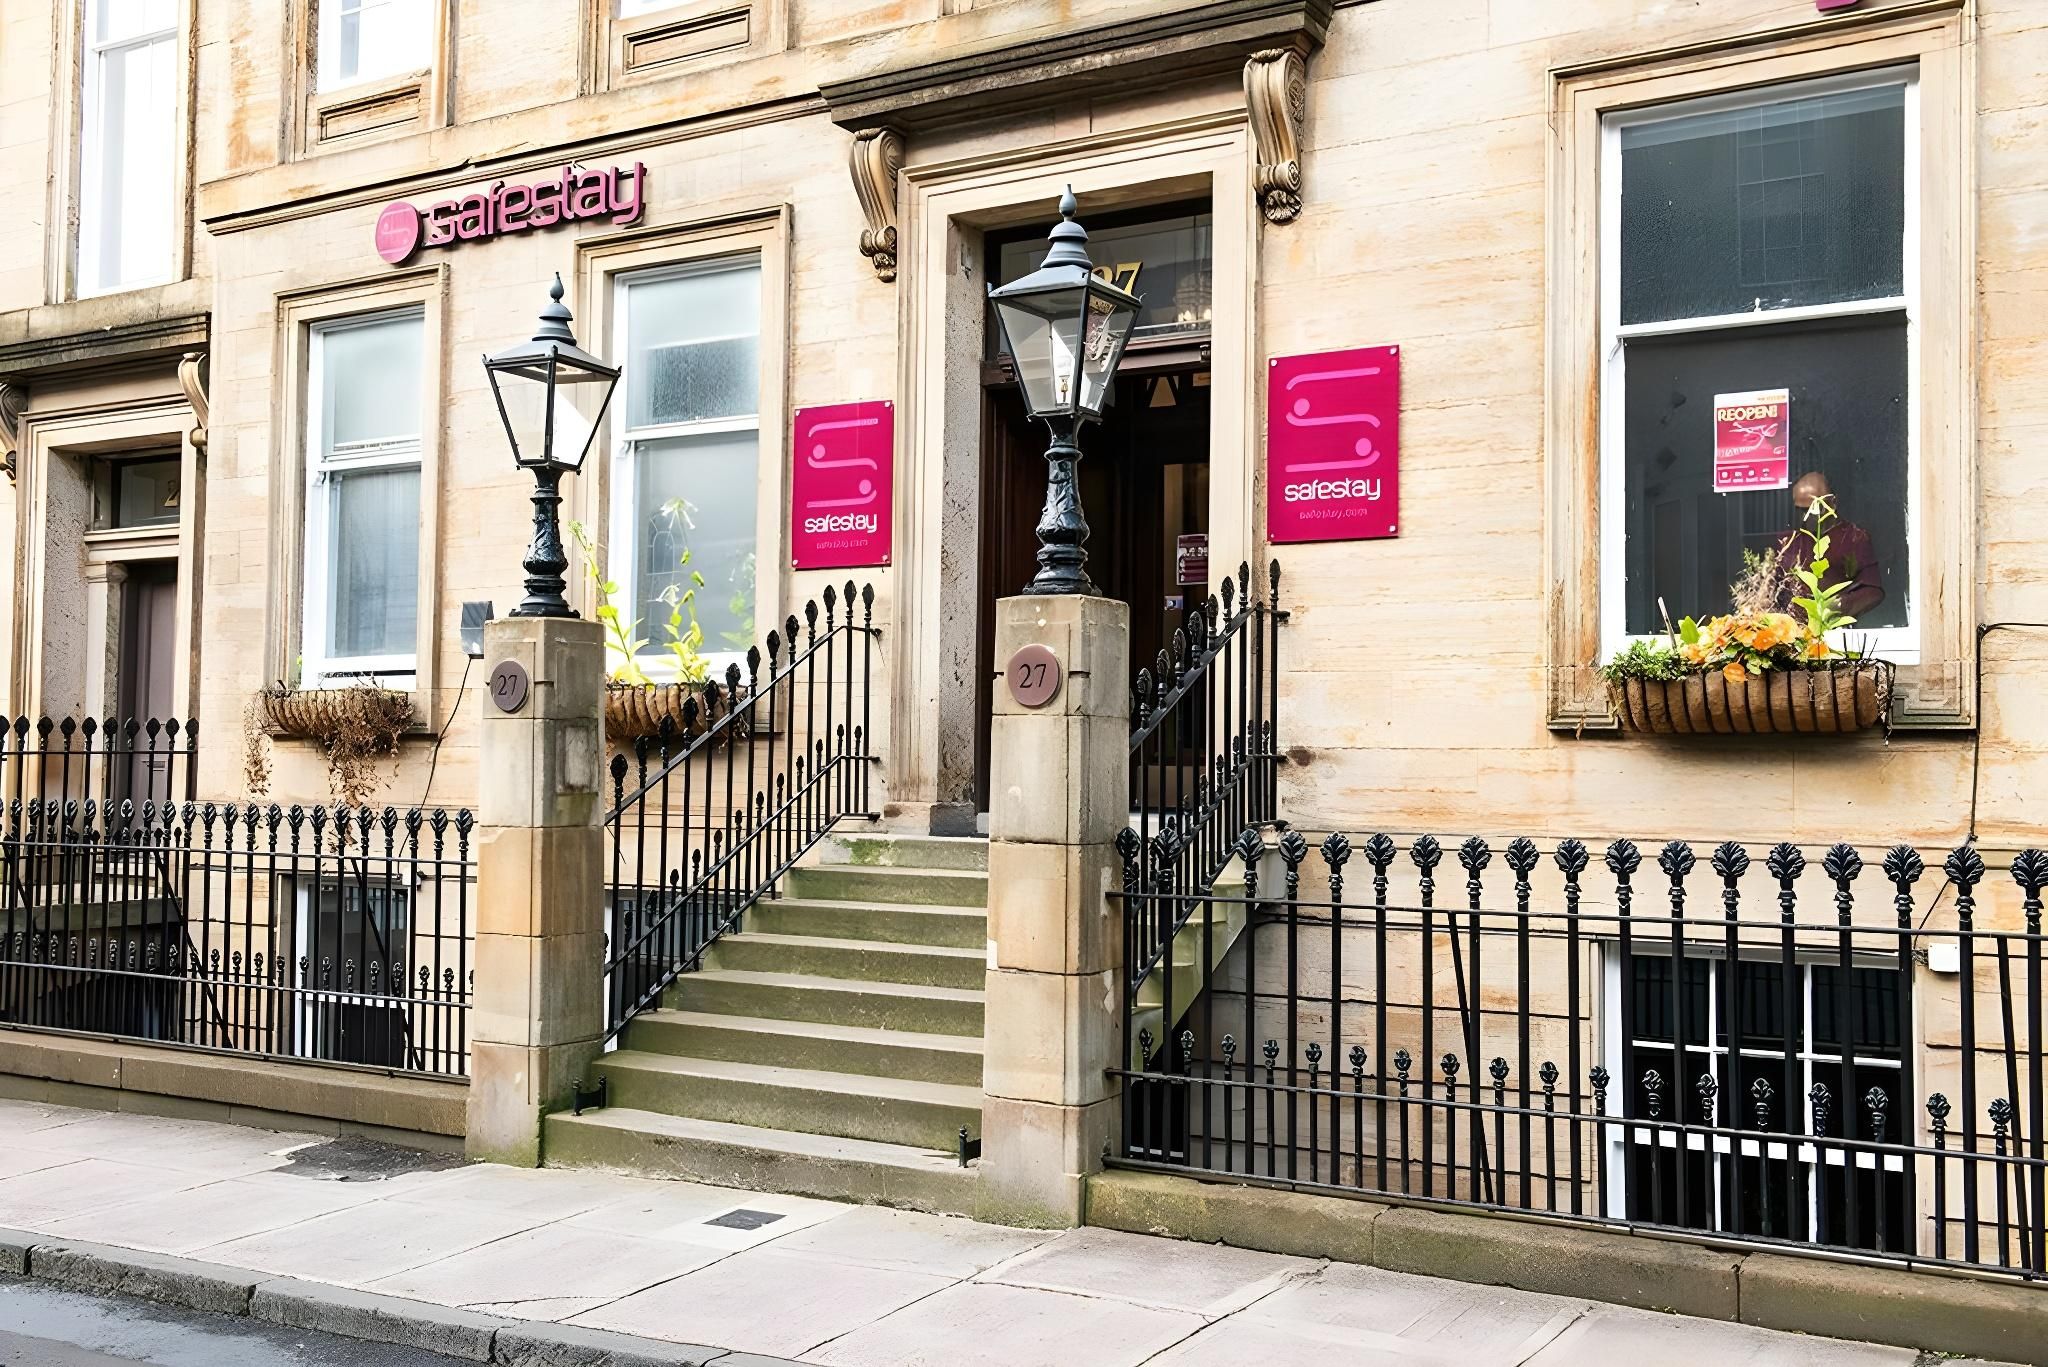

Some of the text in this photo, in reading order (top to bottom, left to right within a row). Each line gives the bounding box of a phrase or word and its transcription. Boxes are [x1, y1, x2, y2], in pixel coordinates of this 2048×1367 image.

[425, 161, 646, 245] safestay
[1284, 477, 1381, 502] safestay
[804, 512, 878, 534] safestay
[497, 674, 518, 696] 27
[1018, 663, 1047, 689] 27
